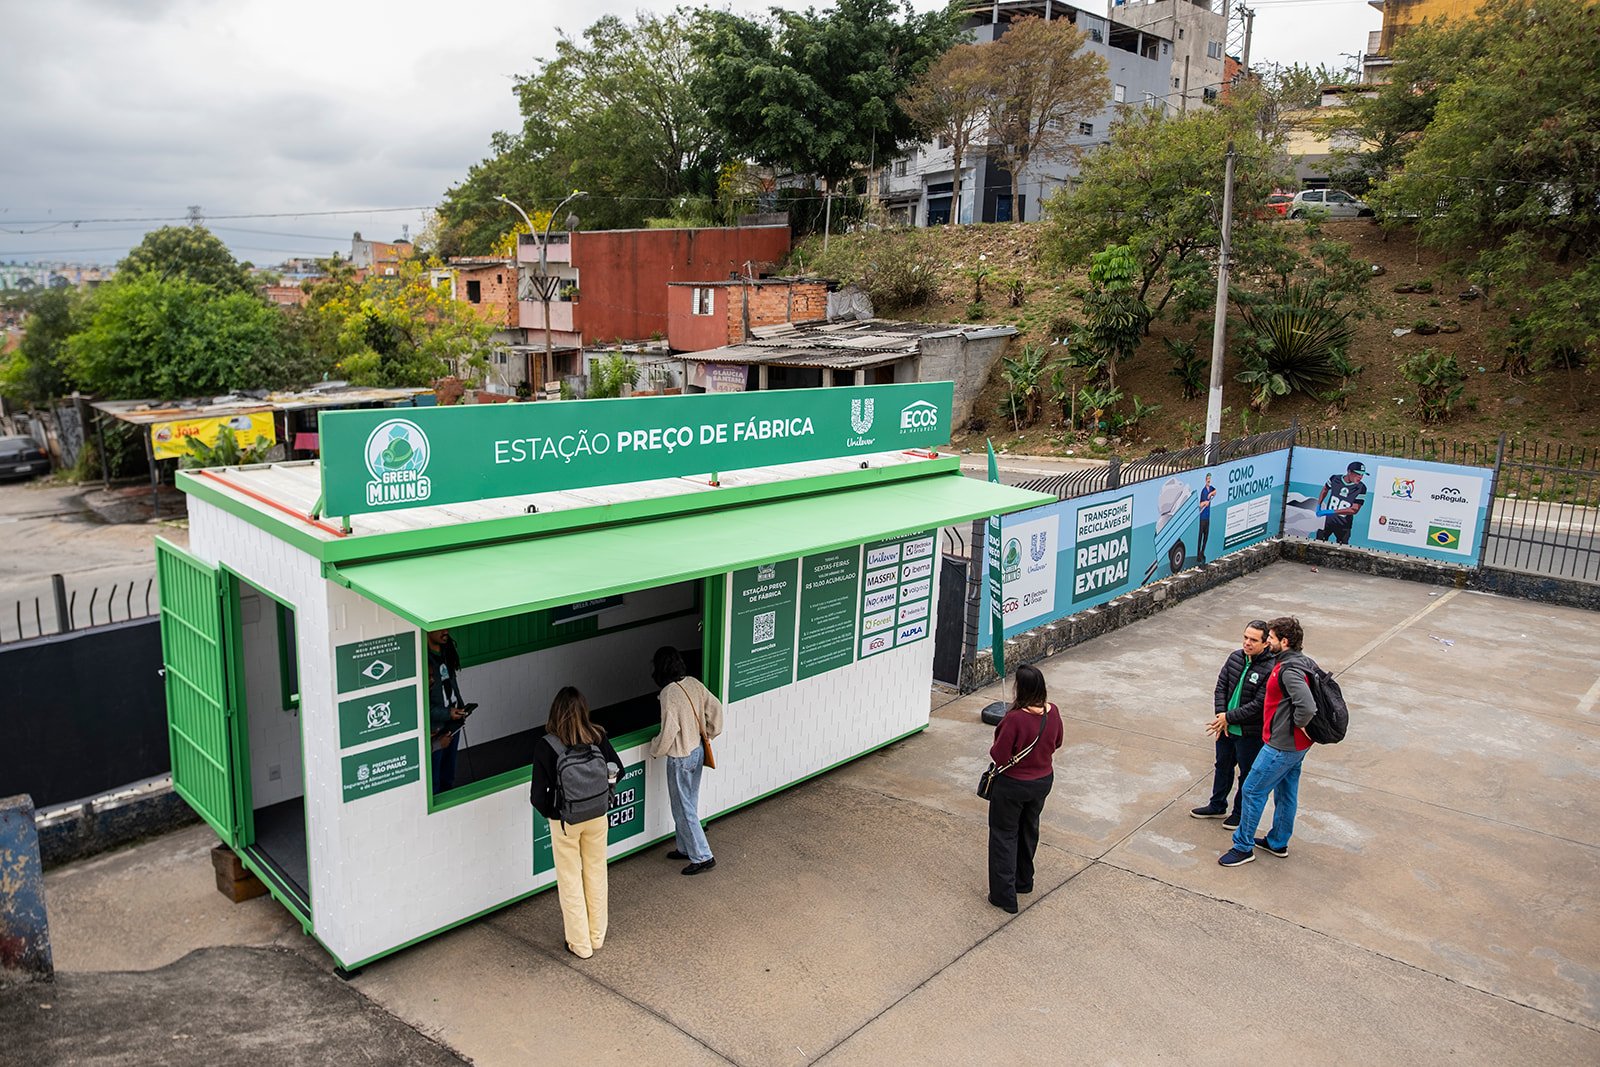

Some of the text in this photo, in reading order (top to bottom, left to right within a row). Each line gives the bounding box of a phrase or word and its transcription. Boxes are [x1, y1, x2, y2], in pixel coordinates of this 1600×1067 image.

[903, 409, 938, 429] ECOS
[495, 416, 815, 464] ESTAÇÃO PREÇO DE FÁBRICA
[847, 436, 876, 447] Unilever
[382, 469, 417, 483] GREEN
[1228, 464, 1254, 484] COMO
[369, 479, 428, 503] MINING
[1227, 475, 1274, 501] FUNCIONA?
[1084, 503, 1127, 523] TRANSFORME
[1079, 513, 1131, 536] RECICLÁVEIS EM
[868, 551, 898, 565] Unilever
[1076, 535, 1129, 570] RENDA
[867, 571, 896, 587] MASSFIX
[1075, 559, 1129, 595] EXTRA!
[743, 581, 787, 597] ESTAÇÃO PREÇO
[758, 590, 781, 600] FÁBRICA
[873, 616, 892, 627] Forest
[901, 626, 923, 639] ALPLA
[869, 639, 885, 651] ECOS
[386, 760, 407, 772] PAULO
